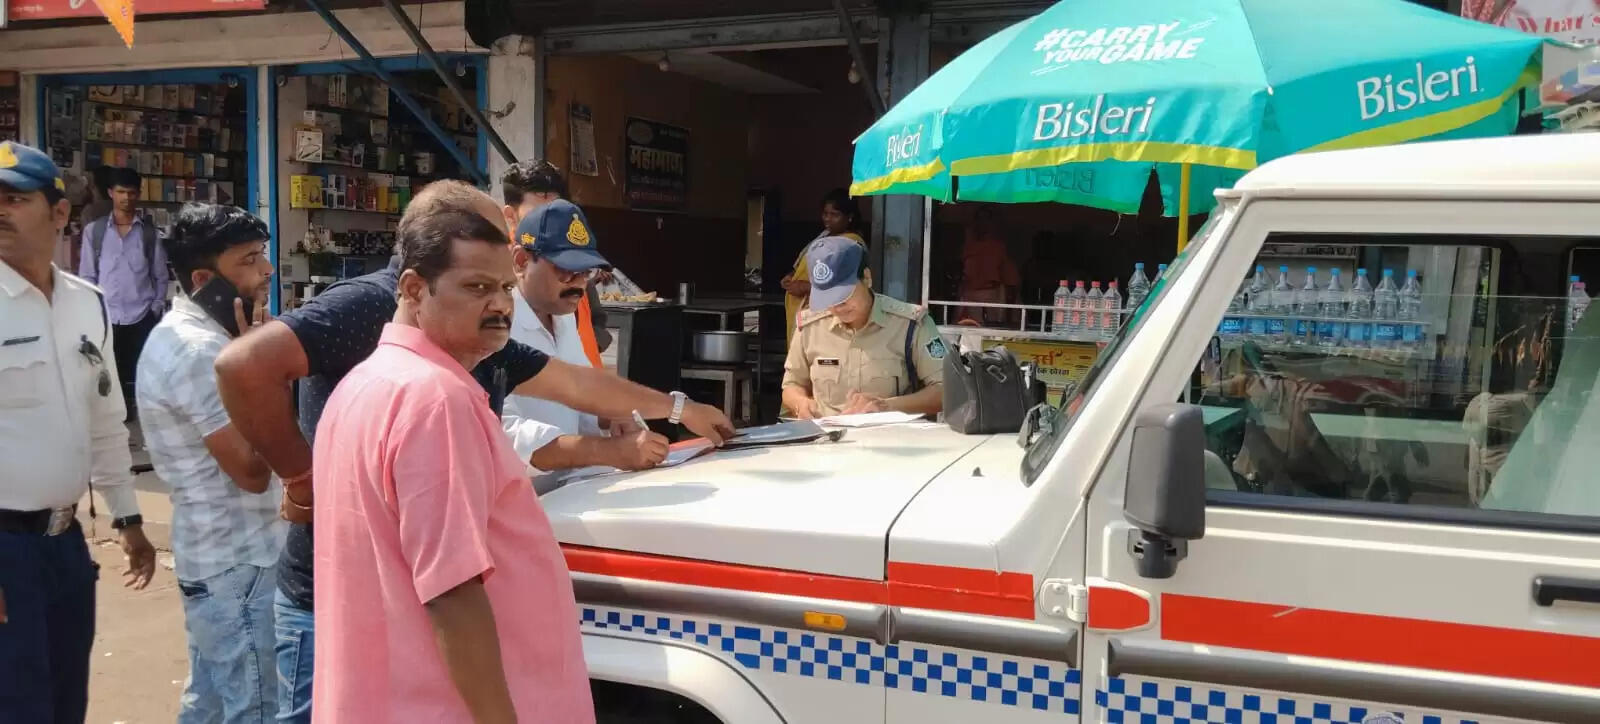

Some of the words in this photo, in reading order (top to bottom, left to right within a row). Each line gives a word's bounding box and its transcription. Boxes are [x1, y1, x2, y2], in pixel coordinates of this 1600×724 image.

[1034, 21, 1180, 50] #CARRY
[1043, 47, 1100, 64] YOUR
[1098, 37, 1205, 64] GAME
[1356, 55, 1478, 120] Bisleri
[1032, 93, 1156, 141] Bisleri
